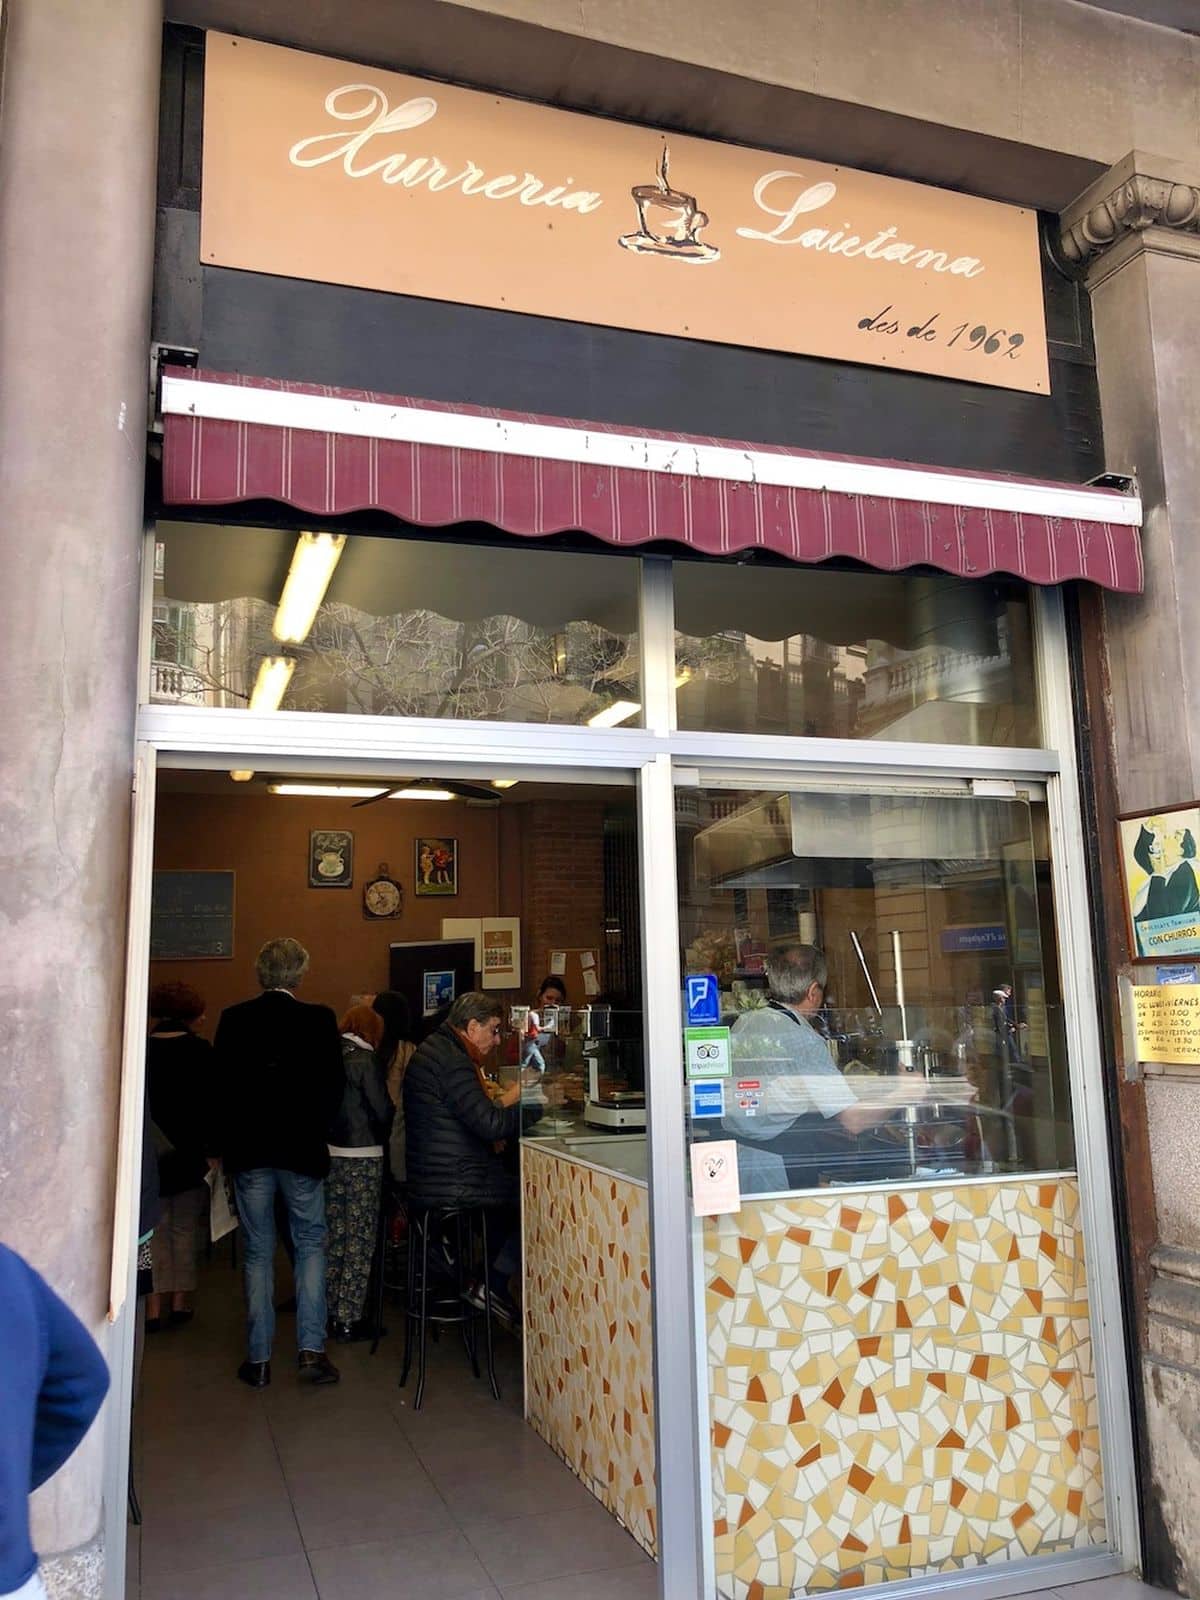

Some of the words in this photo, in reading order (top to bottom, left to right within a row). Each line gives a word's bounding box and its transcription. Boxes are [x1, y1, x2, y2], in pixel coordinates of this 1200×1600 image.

[946, 321, 1025, 360] 1962
[1149, 935, 1164, 946] CON
[1163, 927, 1198, 943] CHURROS
